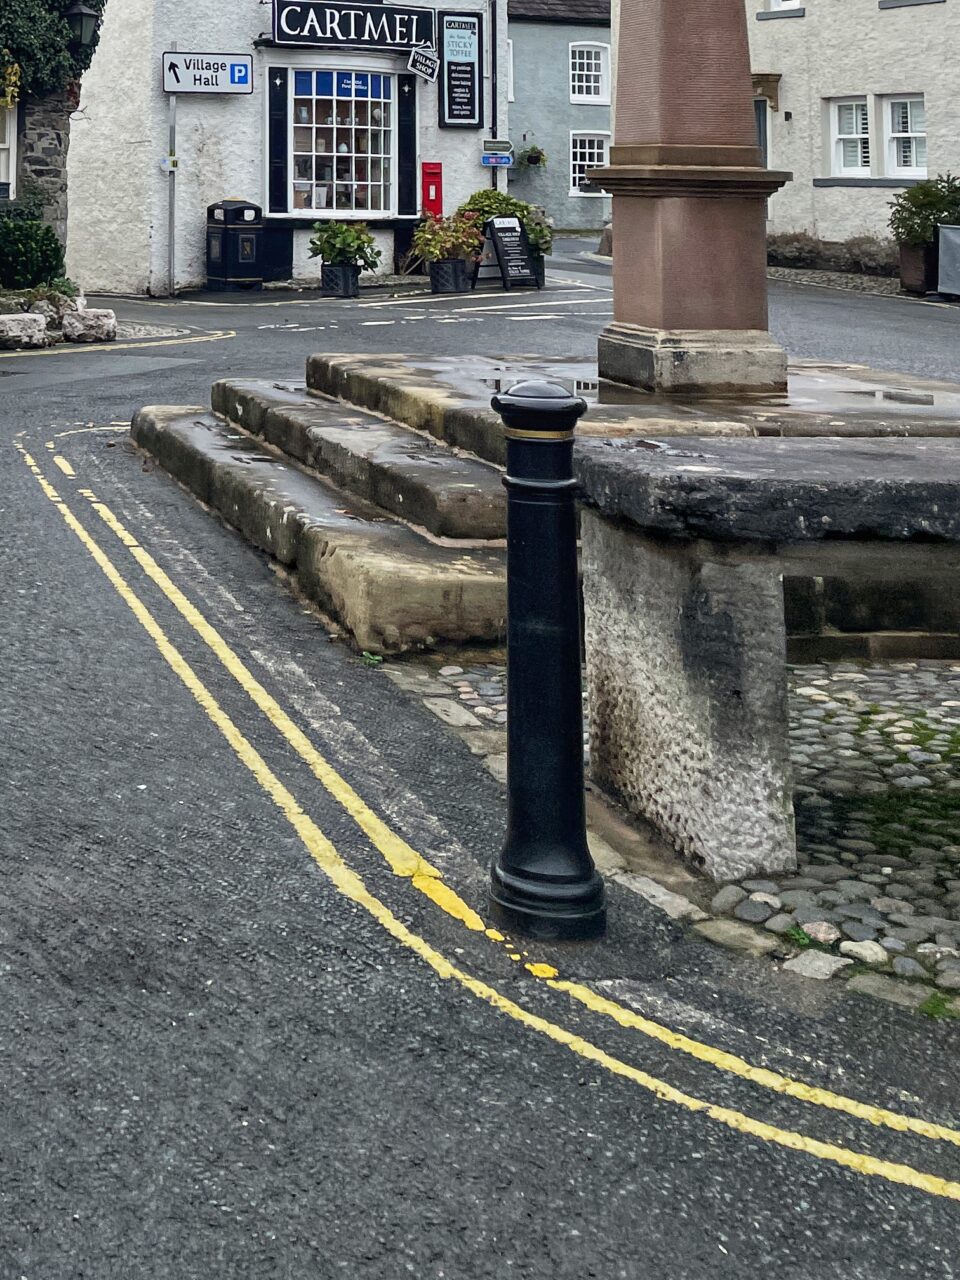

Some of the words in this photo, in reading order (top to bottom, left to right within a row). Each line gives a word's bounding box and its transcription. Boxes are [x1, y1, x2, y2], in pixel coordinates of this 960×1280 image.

[280, 6, 425, 44] CARTMEL
[446, 22, 475, 30] CARTMEL
[447, 40, 473, 49] STICKY
[449, 49, 472, 57] TOFFEE
[184, 58, 227, 72] Village
[414, 53, 437, 69] VILLAGE
[234, 66, 246, 82] P
[415, 62, 433, 75] SHOP
[193, 74, 219, 86] Hall
